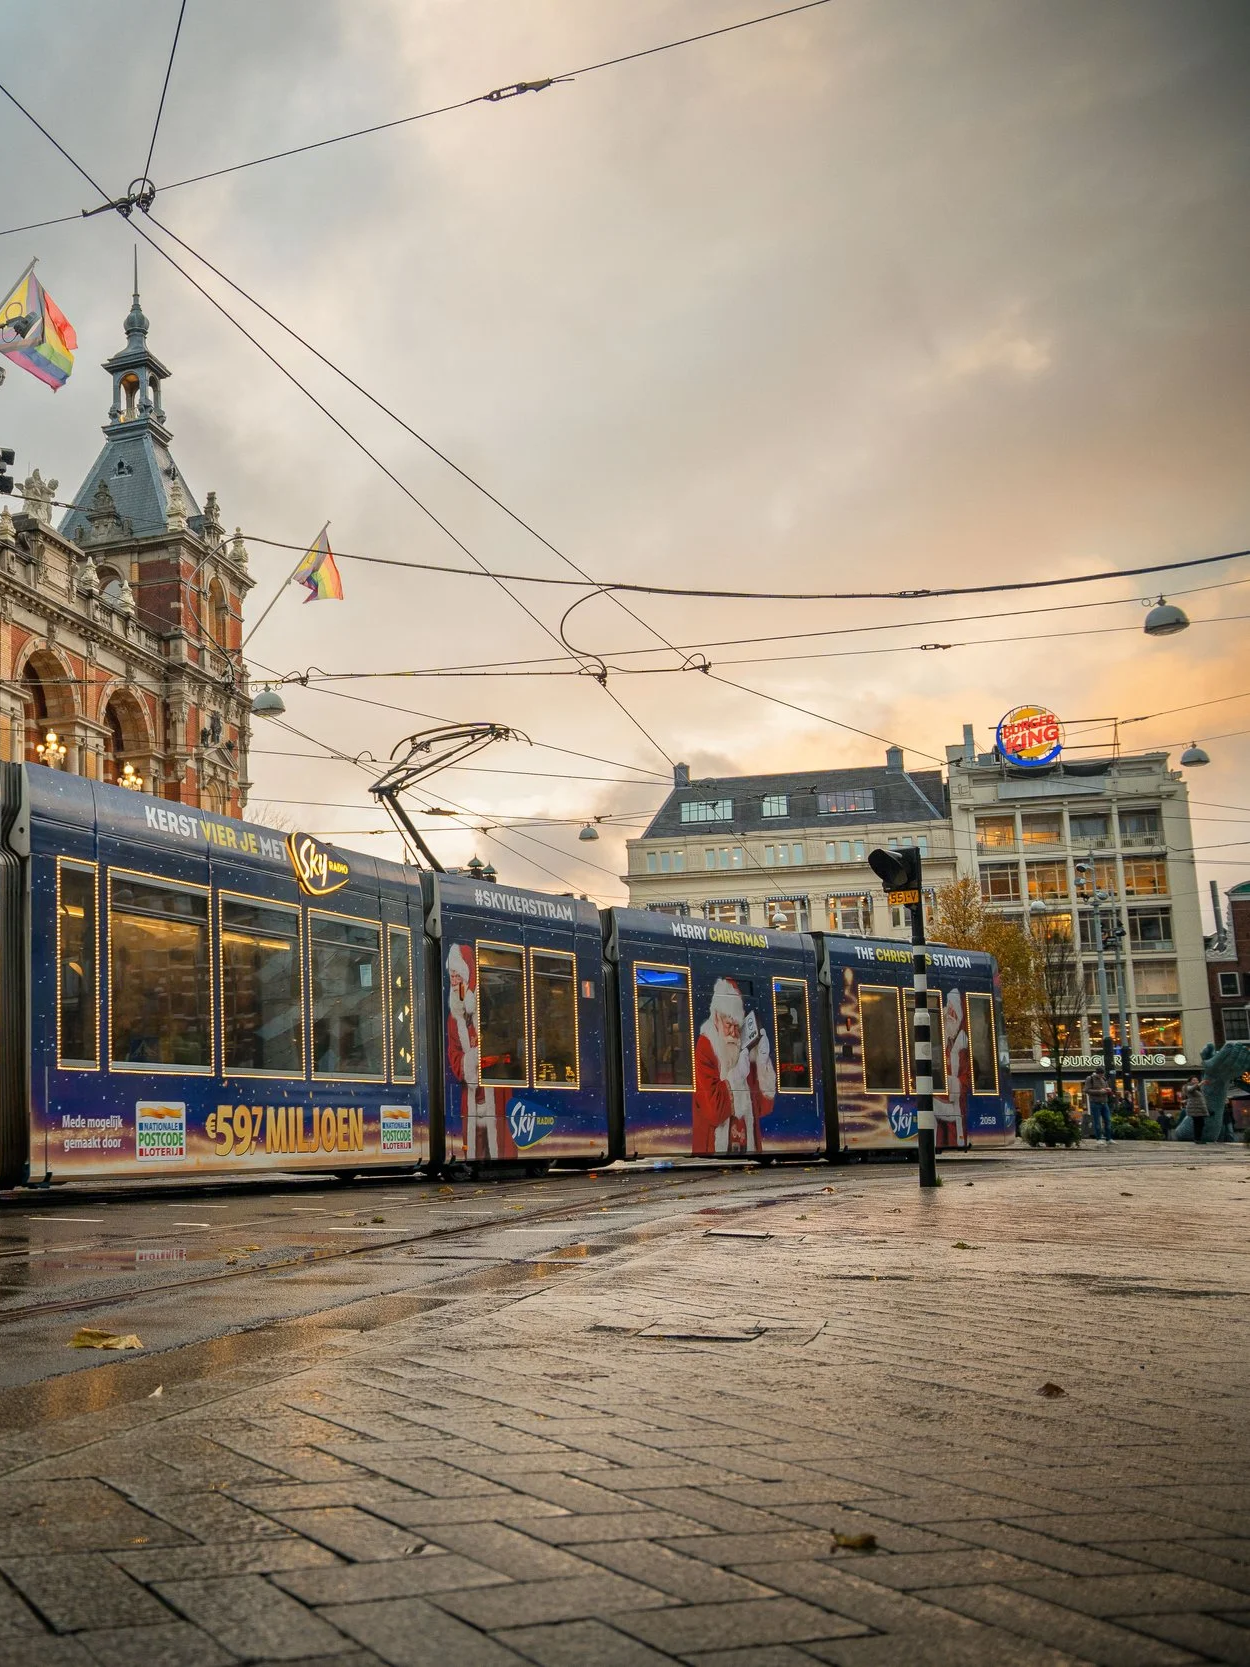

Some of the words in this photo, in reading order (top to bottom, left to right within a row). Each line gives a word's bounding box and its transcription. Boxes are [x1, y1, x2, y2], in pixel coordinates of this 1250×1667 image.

[1003, 715, 1055, 739] BURGER
[1006, 725, 1059, 754] KING
[145, 806, 198, 839] KERST
[200, 820, 238, 849] VIER
[240, 832, 257, 854] JE
[259, 836, 287, 861] MET
[300, 839, 327, 887] Sky
[328, 861, 348, 875] RADIO
[475, 889, 573, 921] #SKYKERSTTRAM
[671, 922, 707, 941] MERRY
[709, 927, 770, 949] CHRISTMAS!
[855, 946, 875, 960] THE
[876, 948, 932, 965] CHRISTS
[933, 954, 972, 968] STATION
[1059, 1054, 1122, 1067] BURGR
[62, 1115, 86, 1128] Mede
[87, 1115, 123, 1130] mogelijk
[143, 1122, 179, 1131] NATIONALE
[265, 1105, 365, 1154] MILJOEN
[511, 1101, 536, 1142] Sky
[536, 1117, 555, 1126] RADIO
[891, 1105, 912, 1135] Sky
[979, 1117, 996, 1125] 2058
[64, 1138, 101, 1152] gemaakt
[102, 1138, 122, 1148] door
[138, 1132, 183, 1147] POSTCODE
[382, 1130, 411, 1141] POSTCODE
[144, 1148, 179, 1156] LOTERIJ
